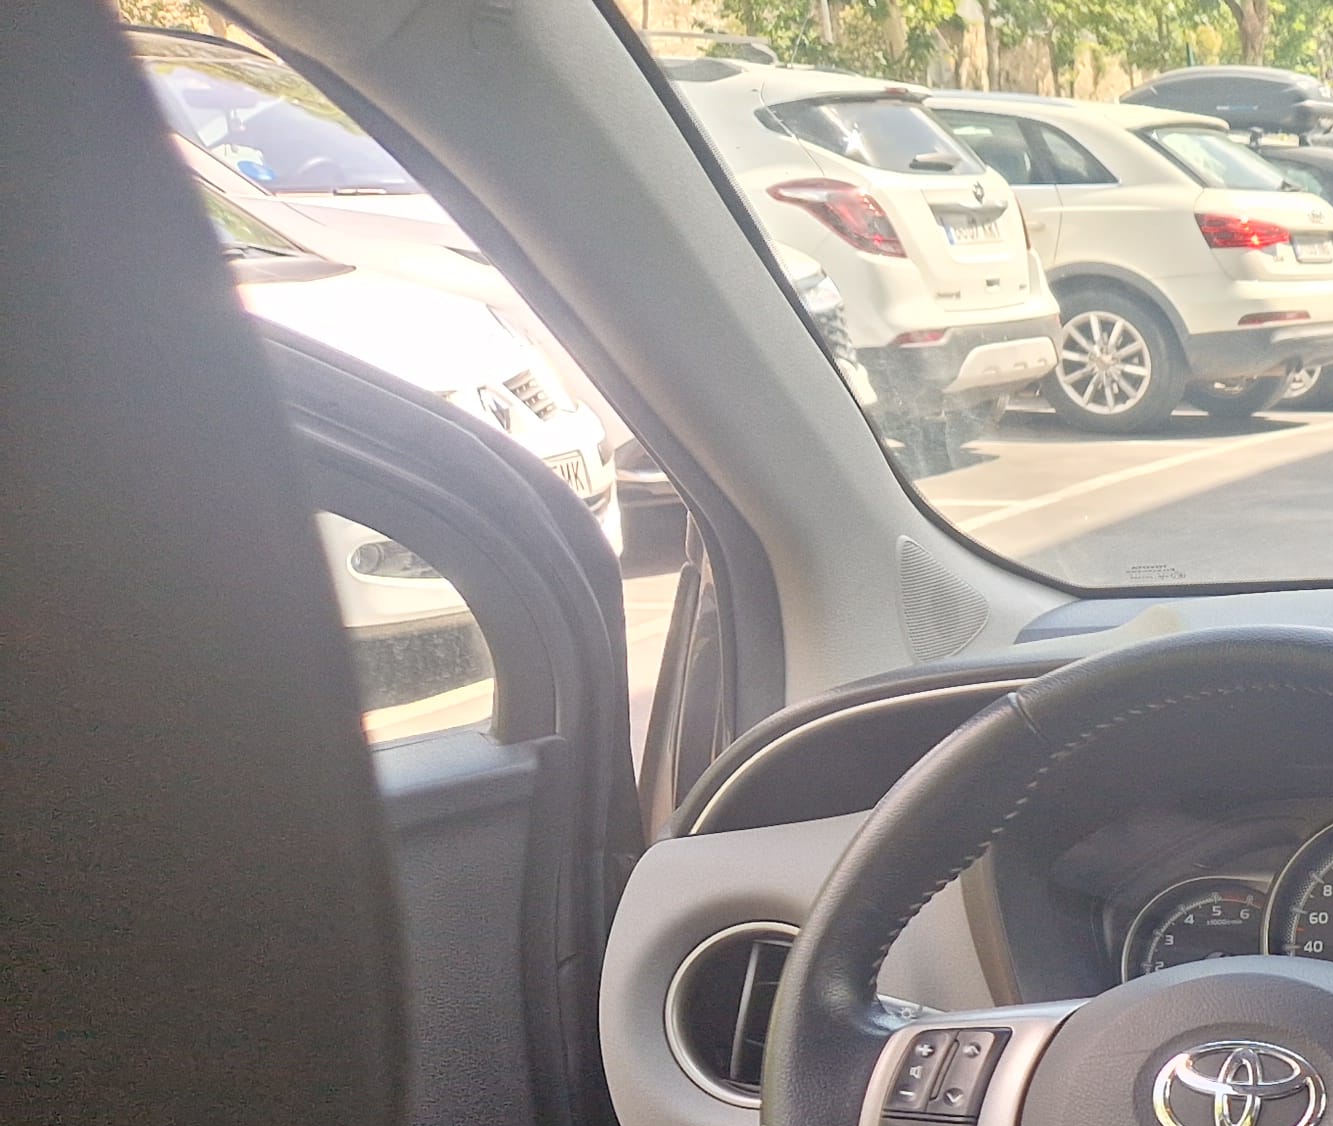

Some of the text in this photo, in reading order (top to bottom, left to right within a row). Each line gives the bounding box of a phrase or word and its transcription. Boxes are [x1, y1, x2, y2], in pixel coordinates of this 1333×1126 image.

[1212, 906, 1222, 916] 5
[1240, 909, 1250, 919] 6
[1184, 914, 1195, 925] 4
[1309, 912, 1329, 924] 60
[1164, 935, 1174, 945] 3
[1304, 940, 1323, 953] 40
